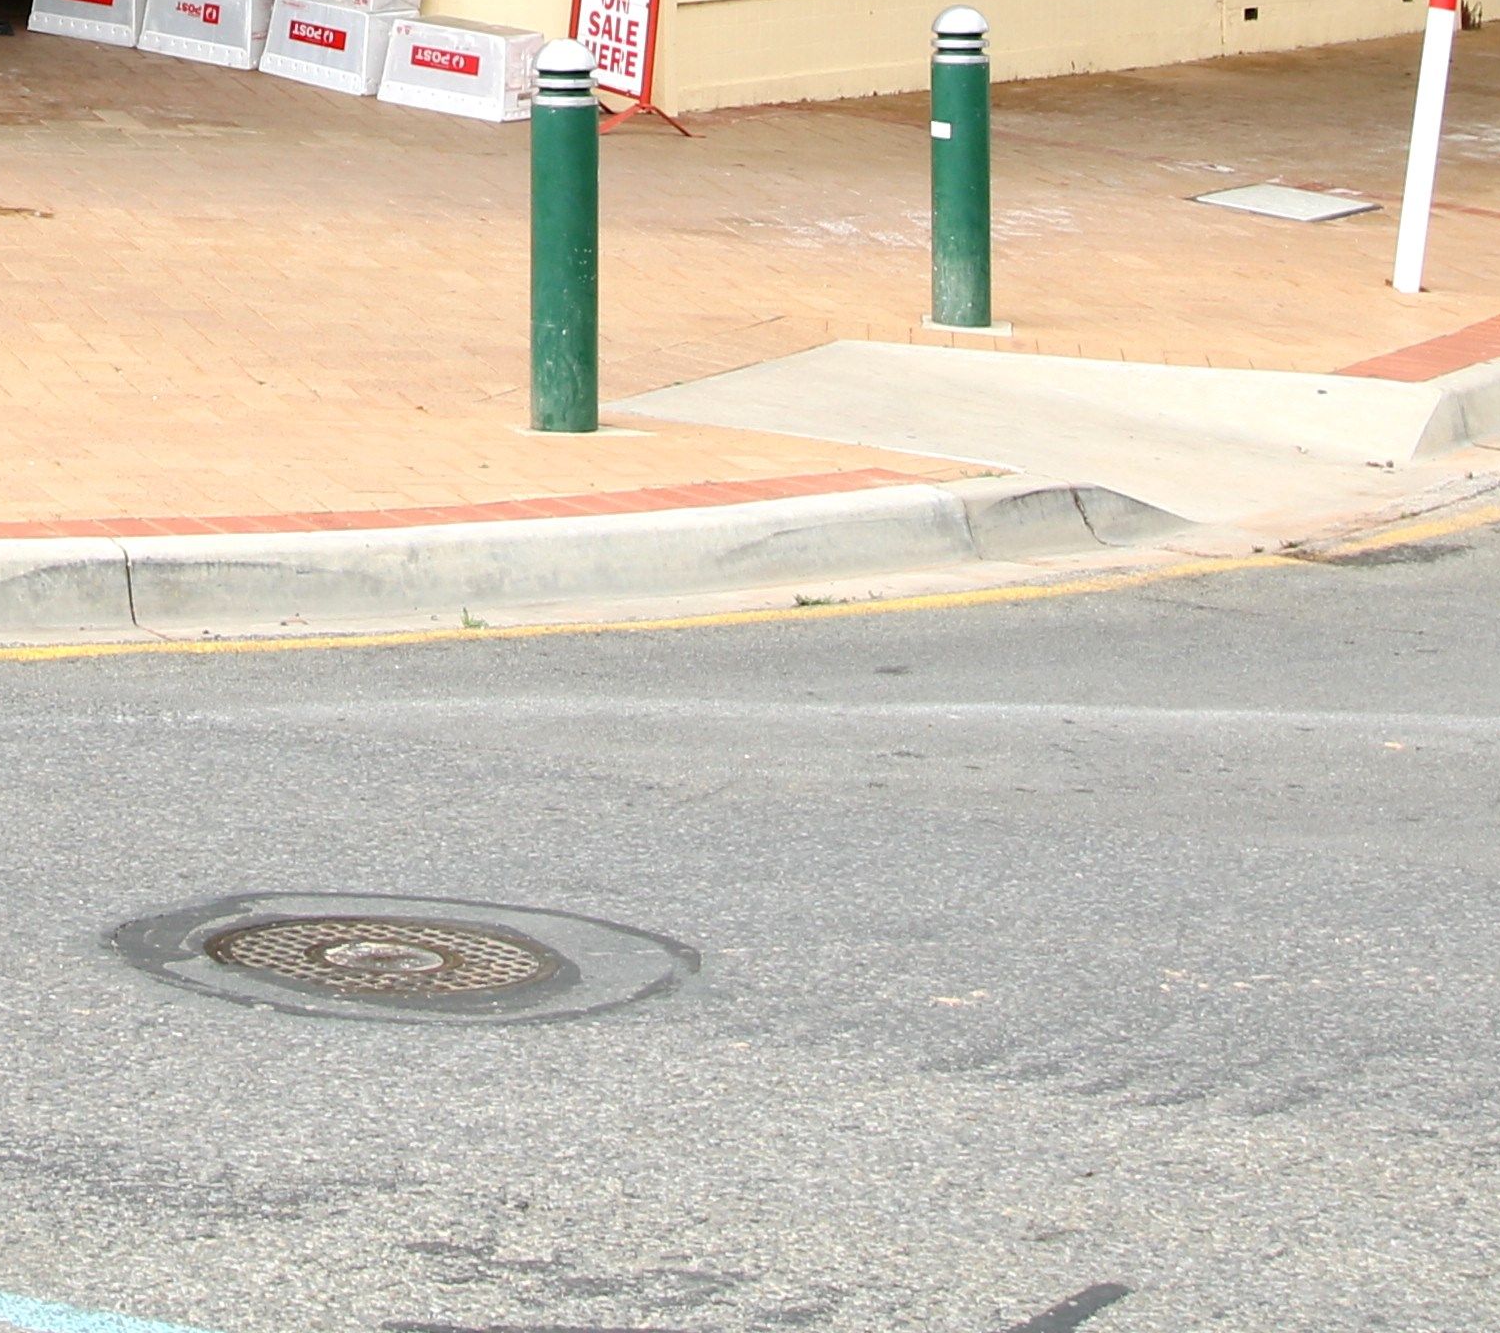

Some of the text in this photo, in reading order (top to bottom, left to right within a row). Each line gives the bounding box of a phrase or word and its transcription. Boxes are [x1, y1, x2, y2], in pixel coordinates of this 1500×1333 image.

[175, 0, 202, 16] POST
[292, 23, 323, 41] POST
[587, 10, 640, 47] SALE
[414, 46, 450, 66] POST
[584, 39, 639, 78] HERE
